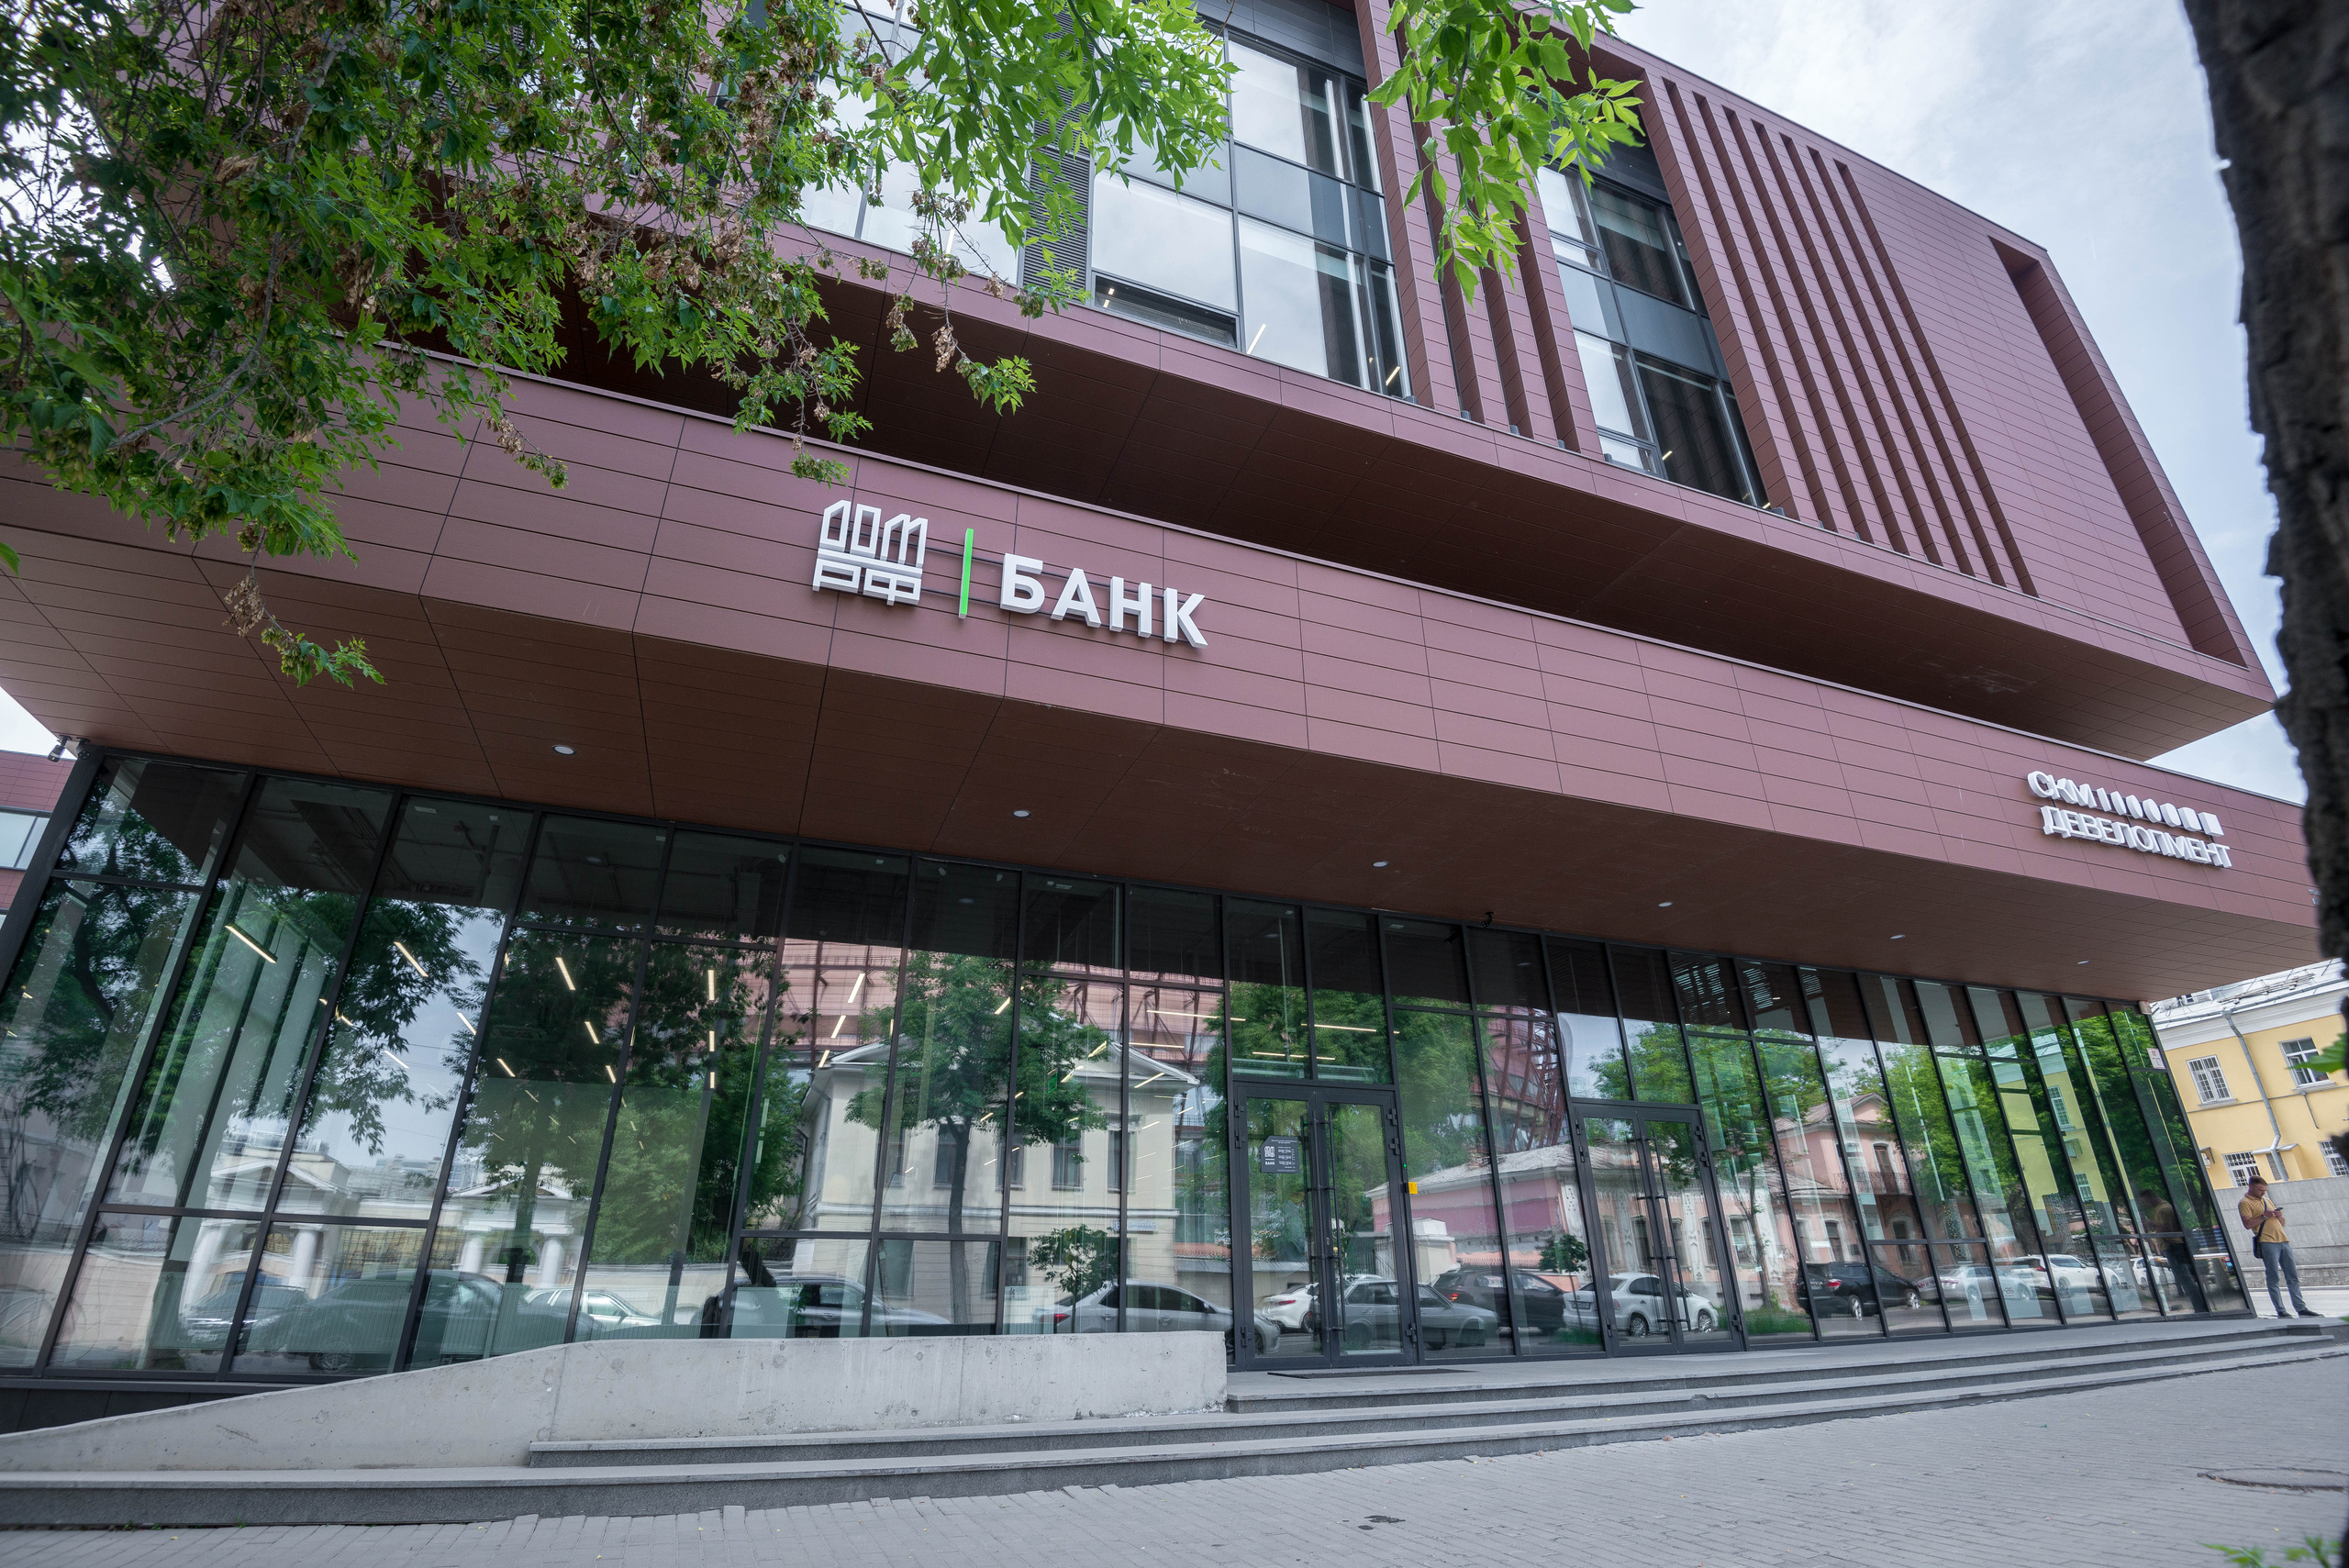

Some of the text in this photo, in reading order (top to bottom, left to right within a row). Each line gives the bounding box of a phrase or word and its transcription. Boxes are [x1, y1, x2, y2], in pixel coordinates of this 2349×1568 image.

[999, 552, 1208, 649] БАНК
[2027, 771, 2098, 809] СКМ
[2039, 805, 2232, 868] ДЕВЕЛОПМЕНТ
